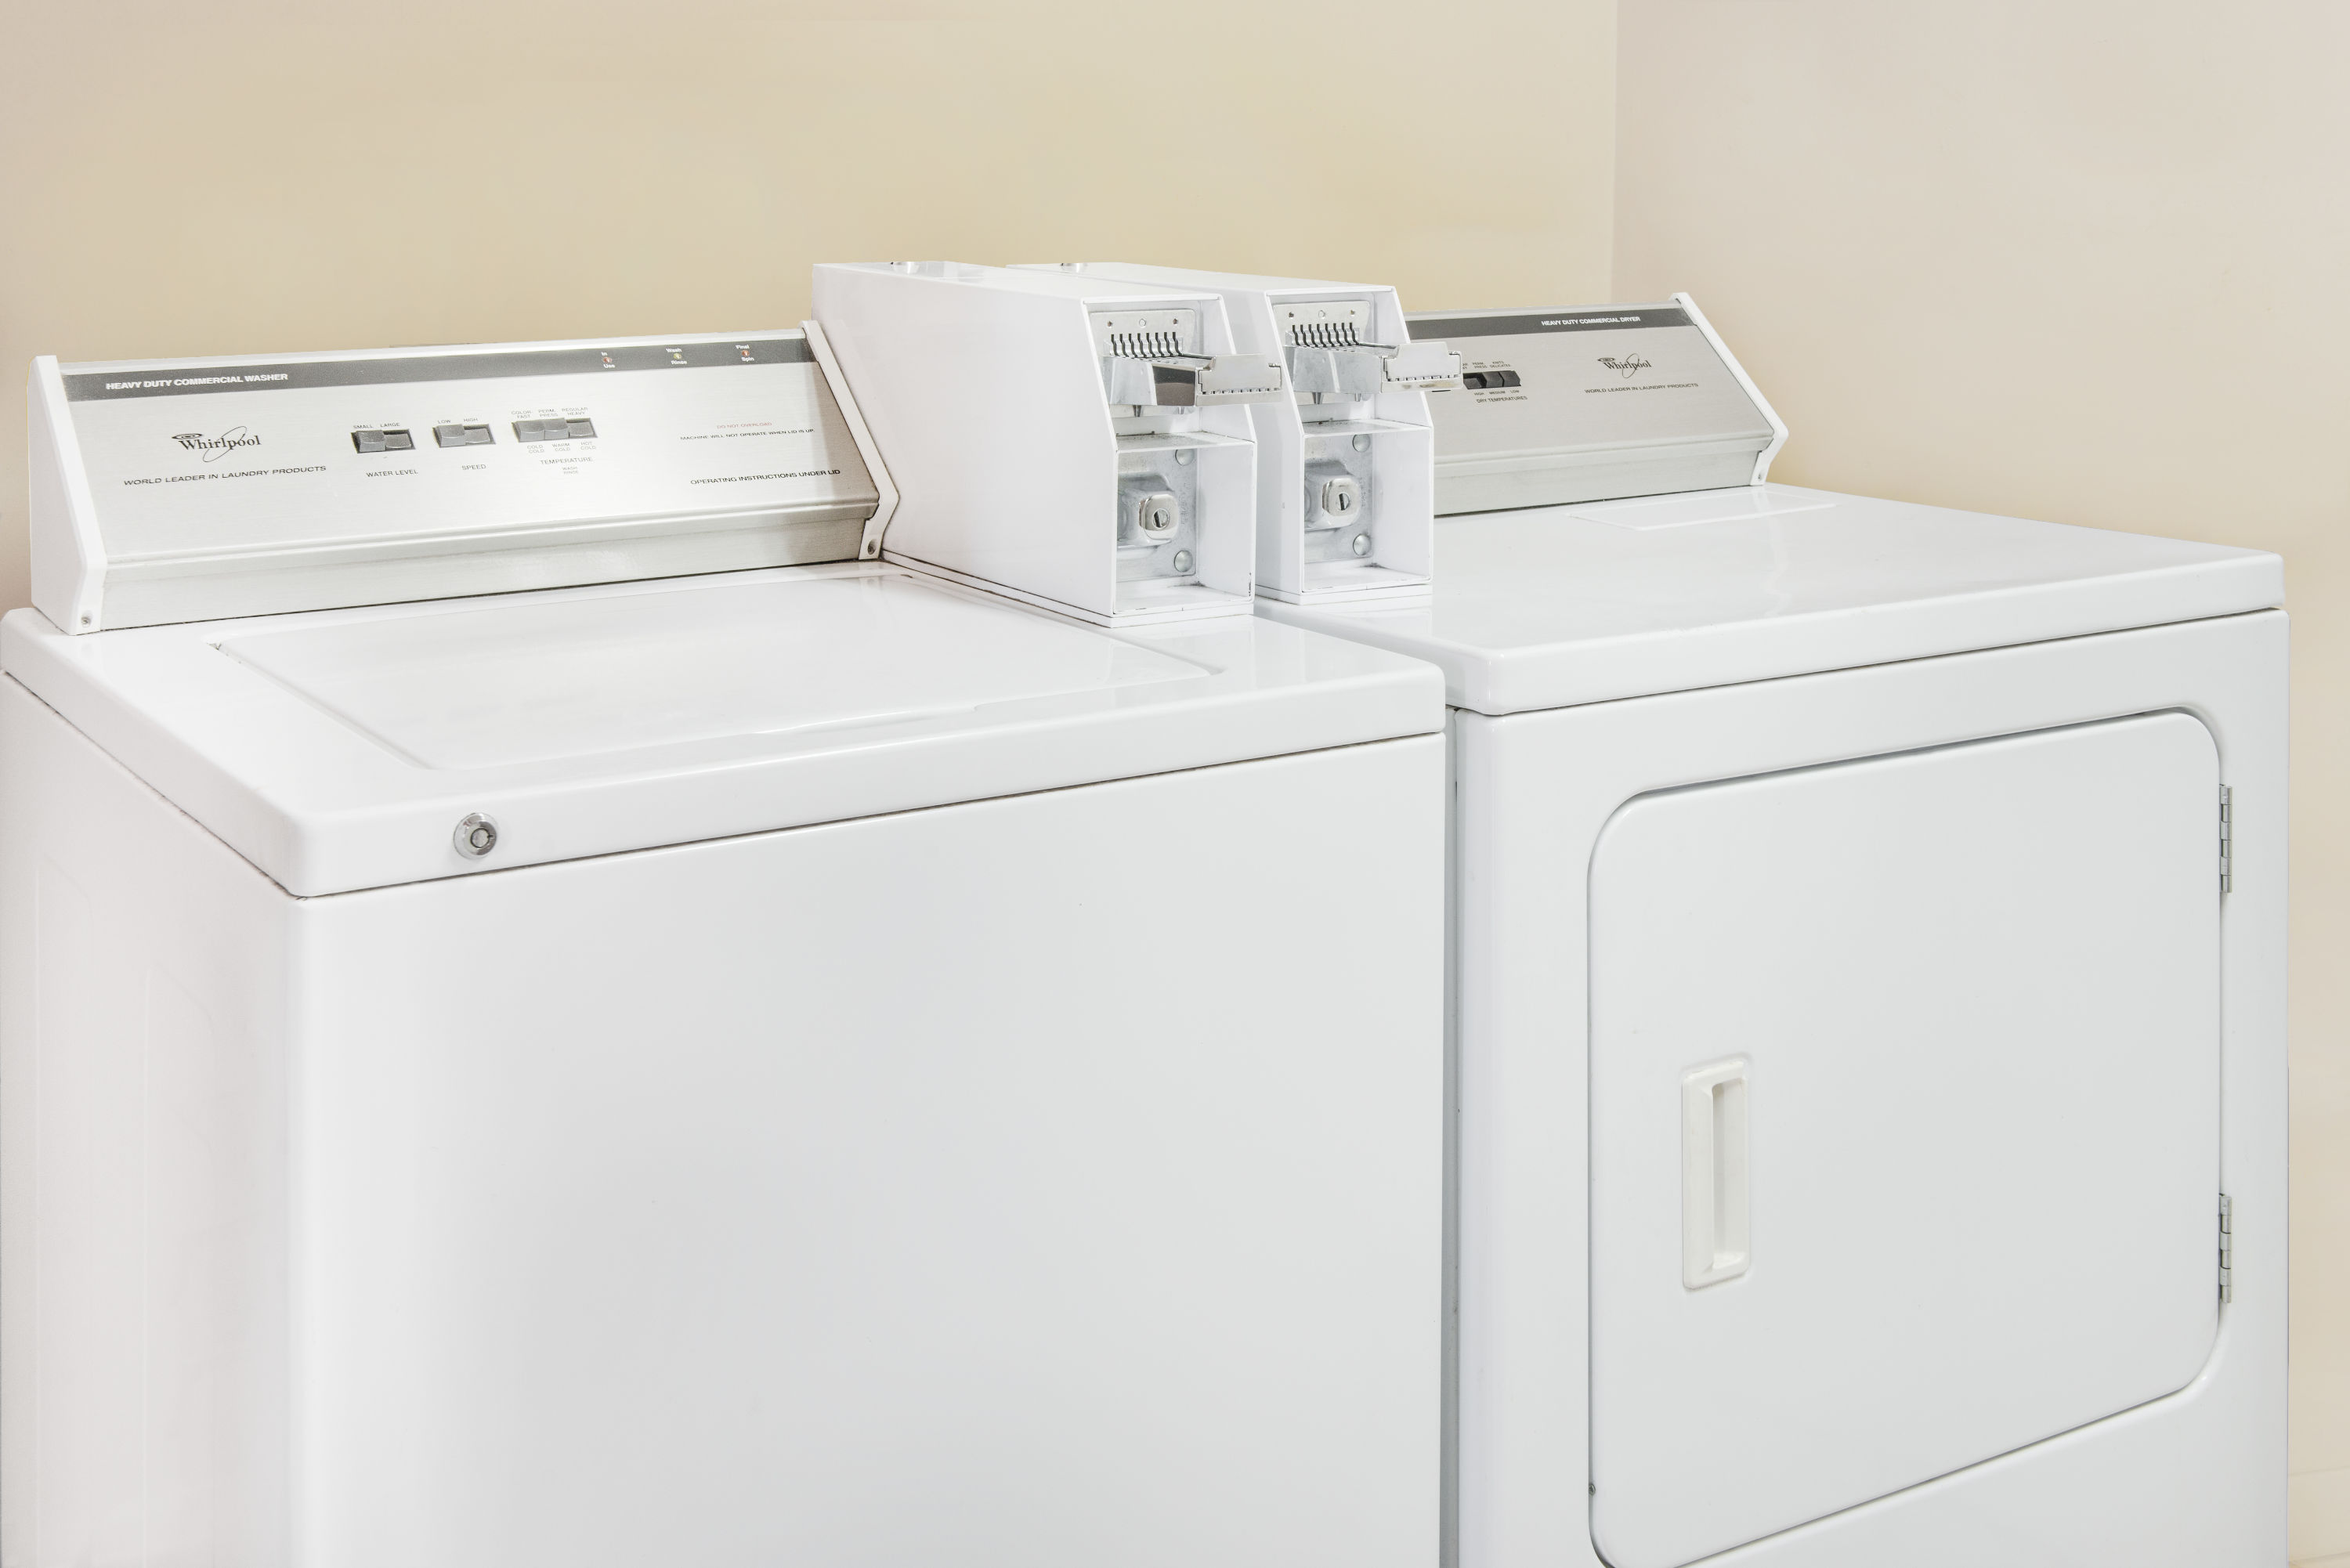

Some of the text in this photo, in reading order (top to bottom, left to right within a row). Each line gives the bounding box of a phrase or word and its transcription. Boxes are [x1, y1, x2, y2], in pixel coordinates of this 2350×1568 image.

[1603, 359, 1652, 370] Whirlpool
[106, 374, 288, 390] HEAVY DUTY COMMERCIAL WASHER
[179, 435, 261, 450] Whirlpool
[222, 470, 269, 479] LAUNDRY
[272, 466, 327, 475] PRODUCTS
[690, 475, 737, 485] OPERATING
[739, 472, 797, 482] INSTRUCTIONS
